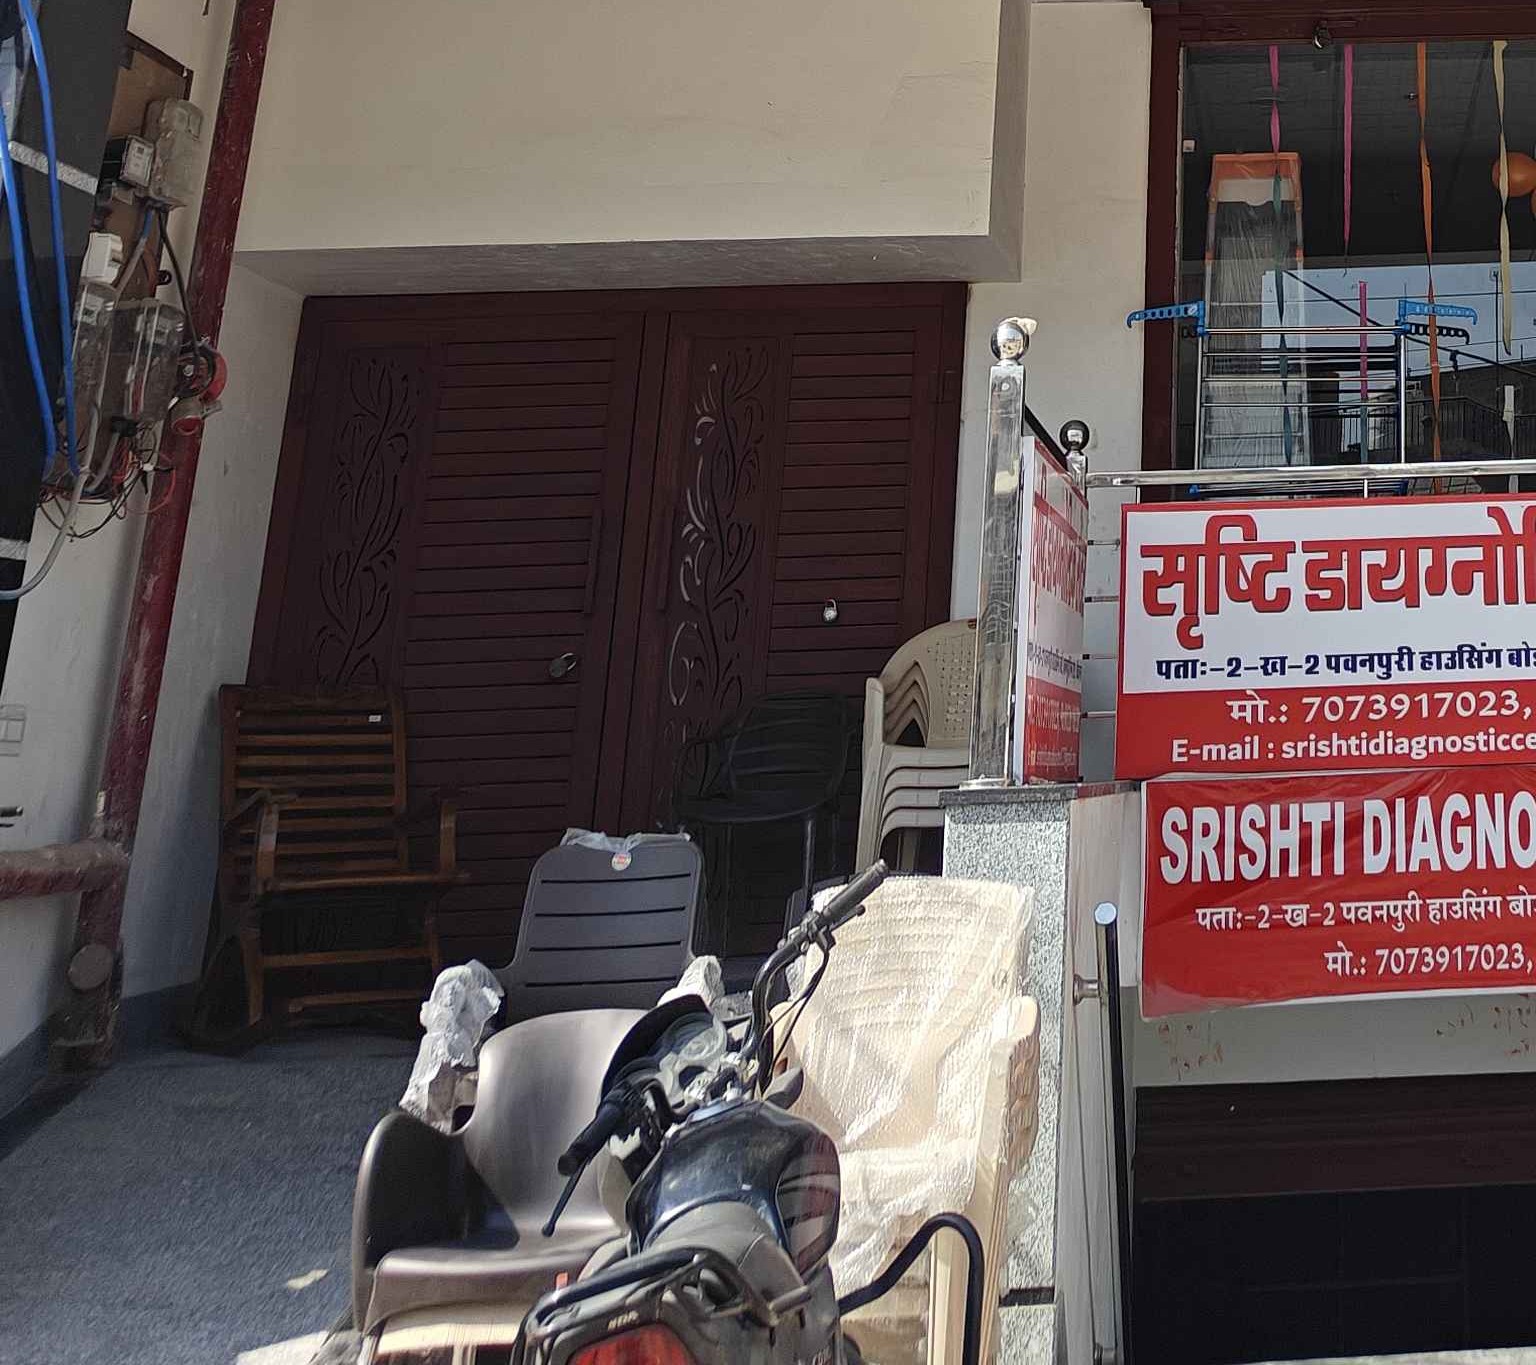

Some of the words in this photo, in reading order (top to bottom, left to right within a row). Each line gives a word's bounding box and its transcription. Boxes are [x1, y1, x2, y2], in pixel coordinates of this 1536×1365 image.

[1140, 515, 1297, 650] सृष्टि
[1325, 645, 1415, 680] पवनपुरी
[1419, 642, 1503, 671] हाउसिंग
[1301, 690, 1532, 724] 7073917023,
[1171, 736, 1260, 763] E-mail
[1159, 800, 1345, 885] SRISHTI
[1341, 890, 1423, 932] पवनपुरी
[1427, 887, 1503, 924] हाउसिंग
[1375, 943, 1534, 976] 7073917023,
